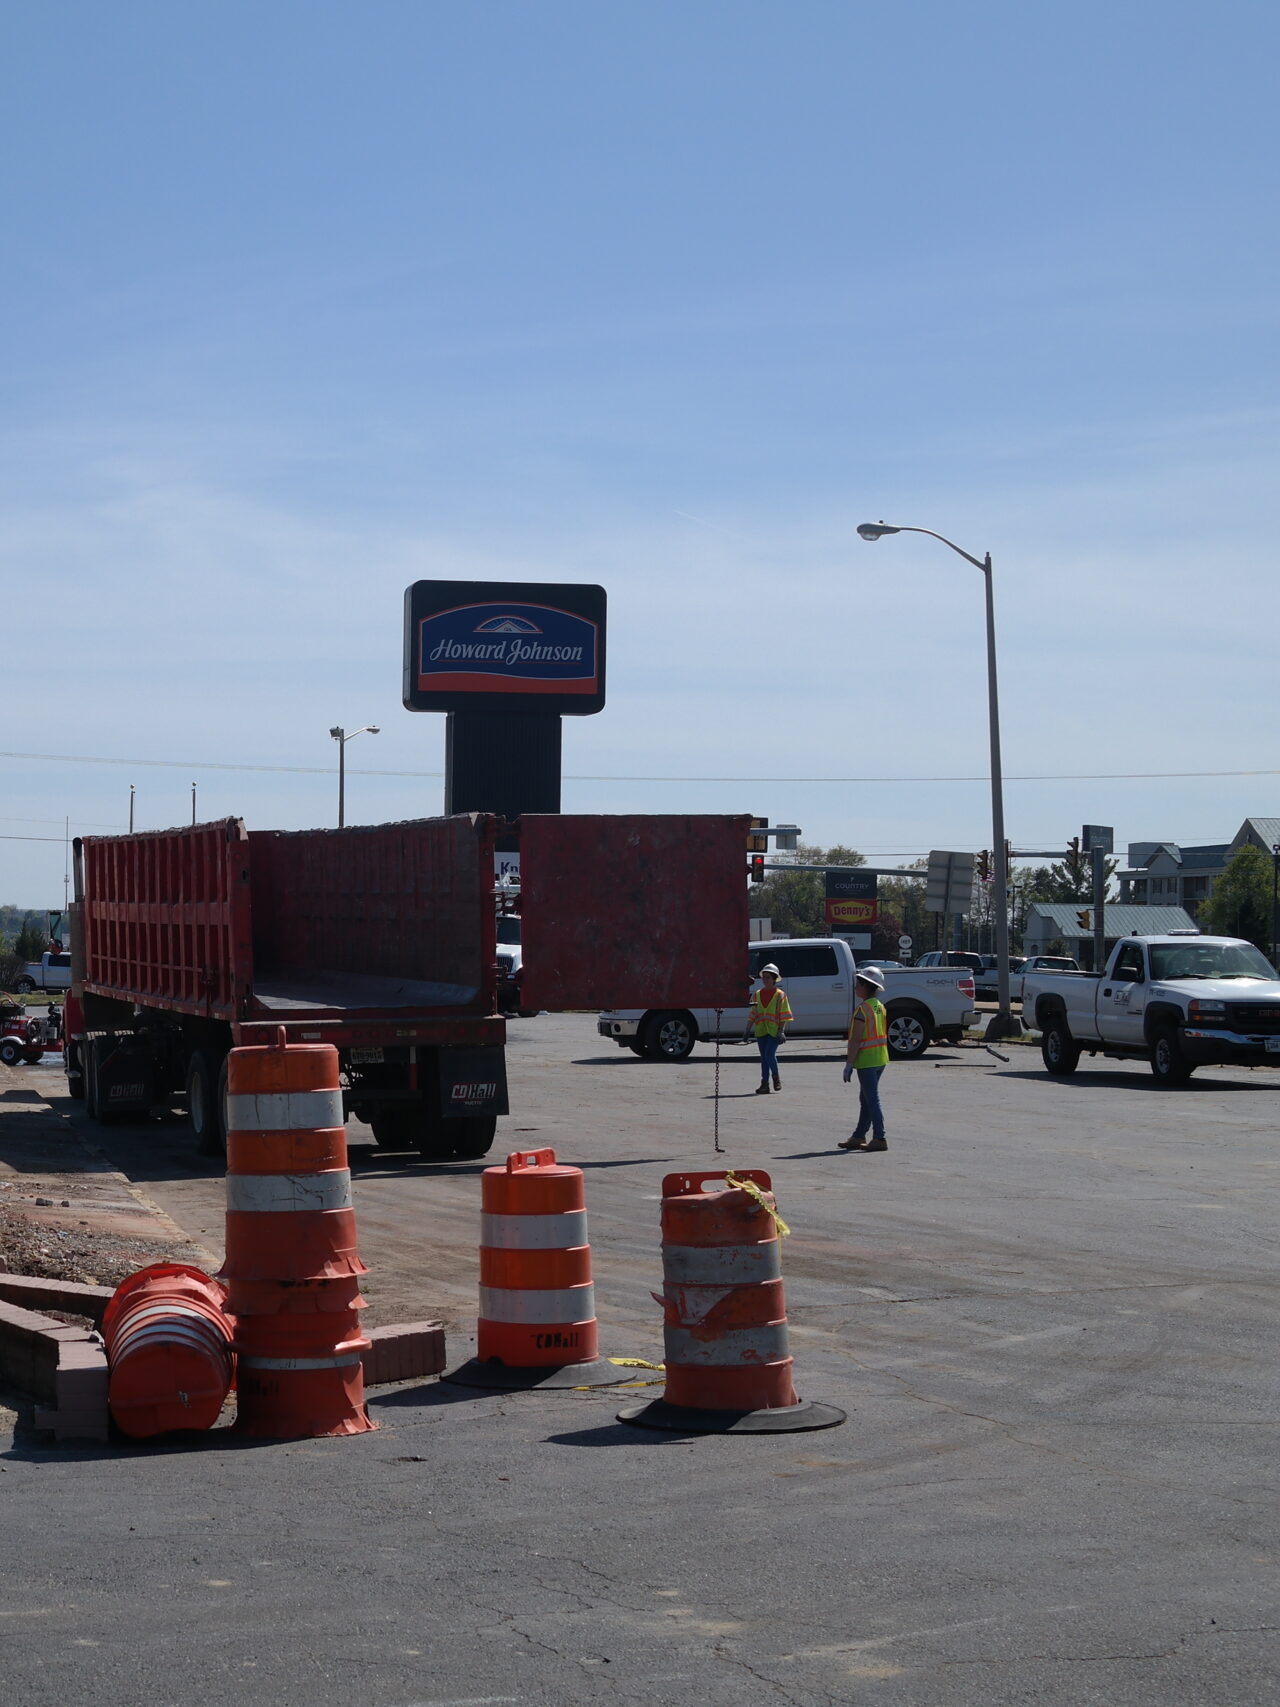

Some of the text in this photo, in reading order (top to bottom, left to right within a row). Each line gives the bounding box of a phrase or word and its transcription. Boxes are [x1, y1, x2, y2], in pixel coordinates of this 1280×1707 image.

[429, 639, 584, 666] Howard Johnson
[834, 905, 870, 917] Denny's
